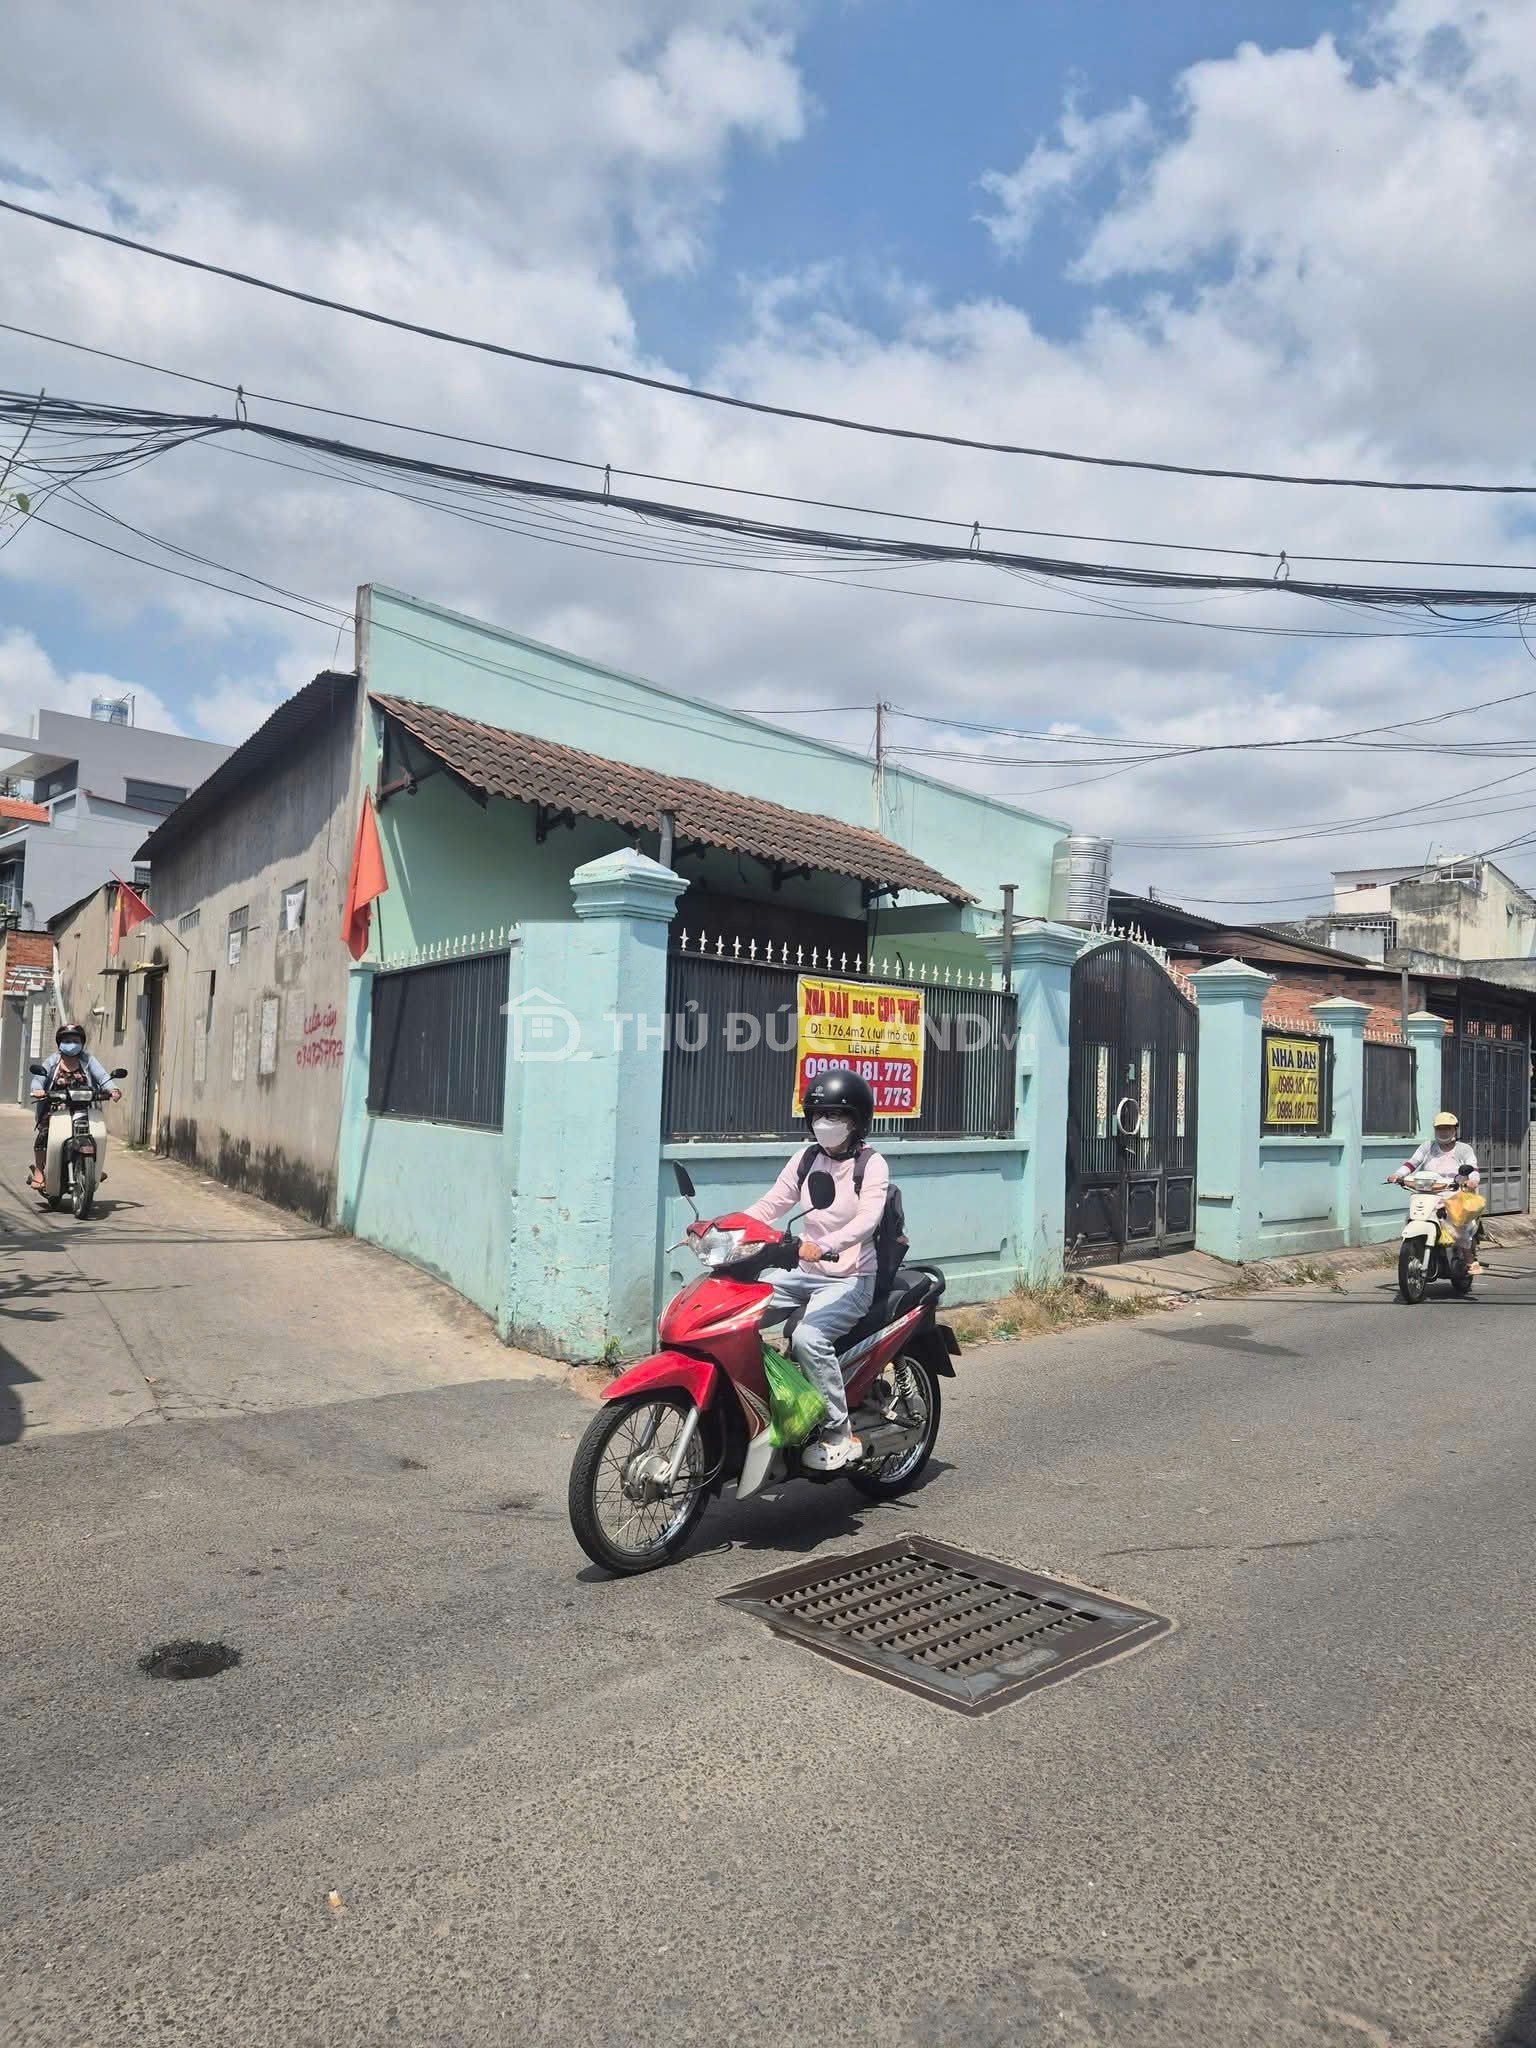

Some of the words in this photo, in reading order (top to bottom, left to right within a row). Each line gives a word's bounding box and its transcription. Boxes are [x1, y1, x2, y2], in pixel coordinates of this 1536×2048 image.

[805, 982, 826, 1016] NHÀ
[829, 985, 849, 1019] BÁN
[878, 995, 895, 1023] CHO
[828, 1023, 865, 1038] 176,4m2
[848, 1042, 867, 1054] LIÊN
[869, 1043, 880, 1057] HỆ
[1296, 1046, 1317, 1070] BÁN
